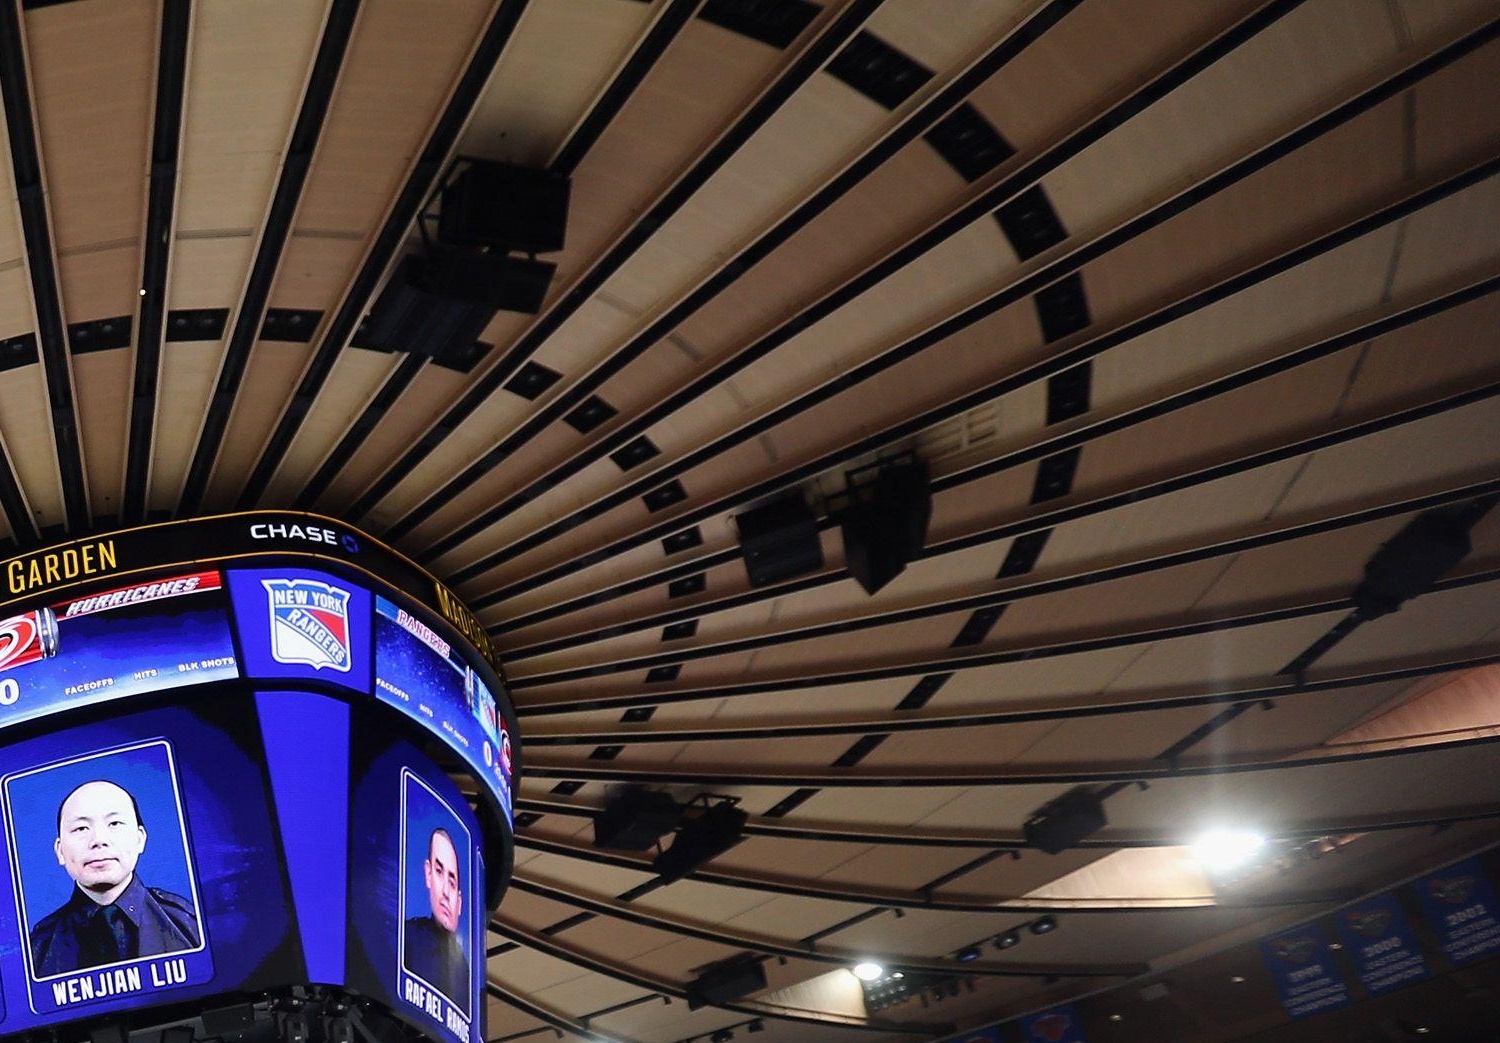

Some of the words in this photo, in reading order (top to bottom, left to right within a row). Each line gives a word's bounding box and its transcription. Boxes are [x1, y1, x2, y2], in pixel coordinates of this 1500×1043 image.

[250, 523, 338, 546] CHASE
[7, 540, 118, 595] GARDEN
[65, 576, 201, 617] HURRICANES
[274, 589, 308, 605] NEW
[312, 591, 343, 613] YORK
[286, 608, 345, 664] RANGERS
[397, 609, 450, 659] RANGERS
[133, 668, 158, 681] HITS
[178, 661, 199, 673] BLK
[201, 657, 236, 669] SHOTS
[65, 677, 115, 696] FACEOFFS
[52, 966, 142, 1006] WENJIAN
[150, 958, 188, 988] LIU
[404, 977, 444, 1023] RAFAEL
